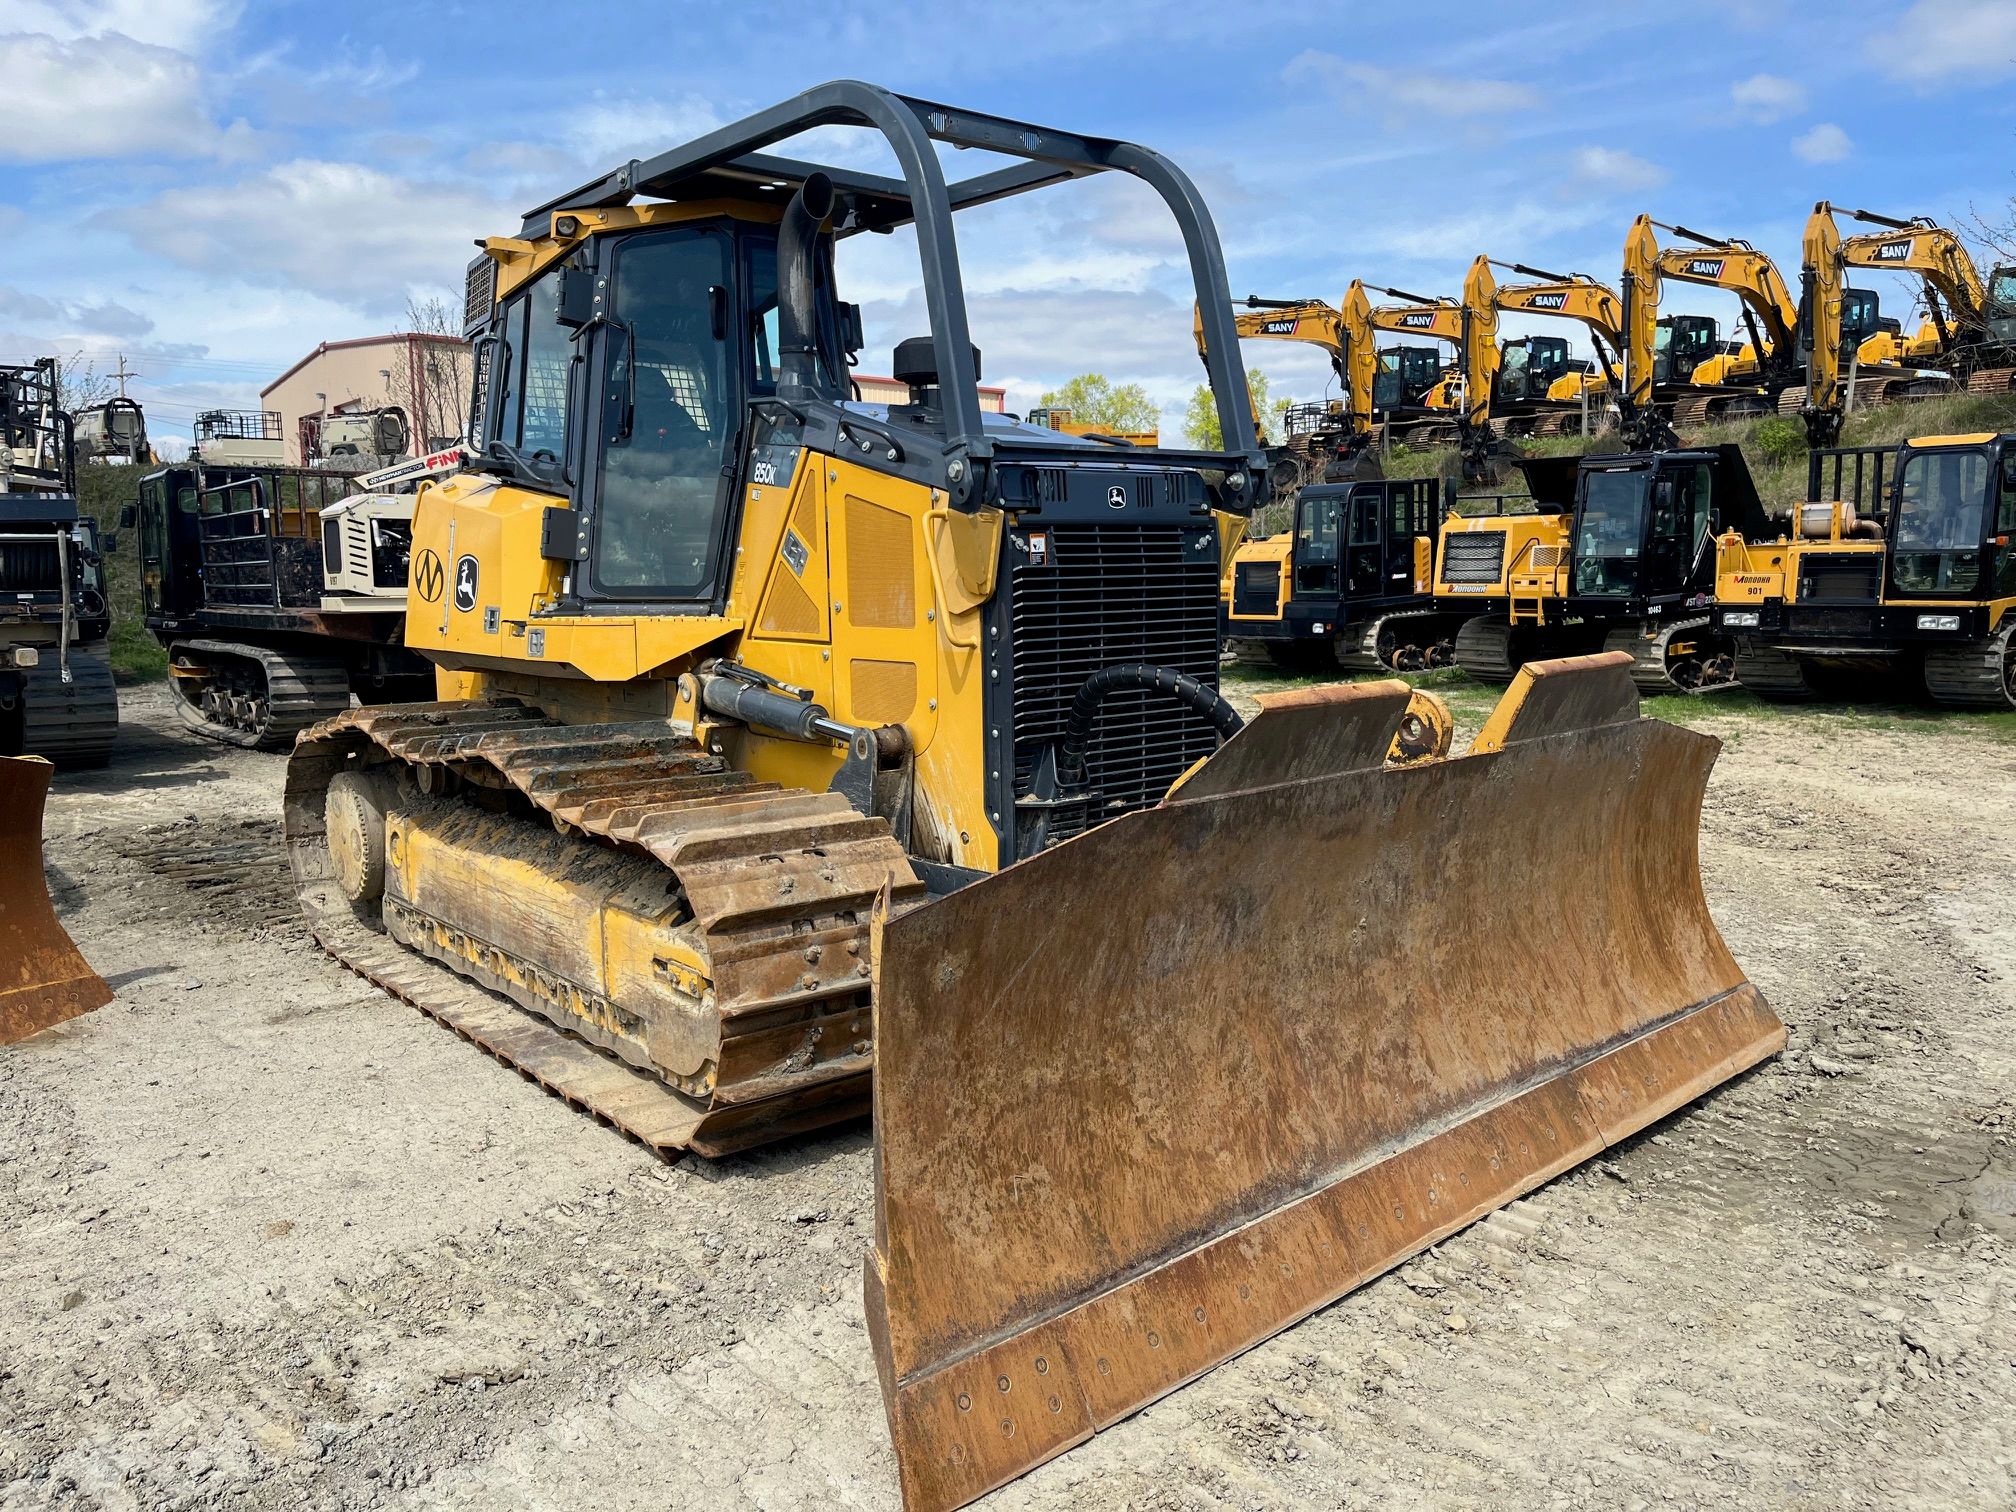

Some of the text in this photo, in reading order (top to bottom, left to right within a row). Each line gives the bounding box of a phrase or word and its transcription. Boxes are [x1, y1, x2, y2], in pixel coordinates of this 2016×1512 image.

[1881, 245, 1907, 258] SANY
[1693, 261, 1719, 274] SANY
[1535, 296, 1562, 306] SANY
[1406, 316, 1431, 326] SANY
[1268, 323, 1293, 332] SANY
[753, 462, 777, 485] 850K
[1747, 587, 1762, 595] 901
